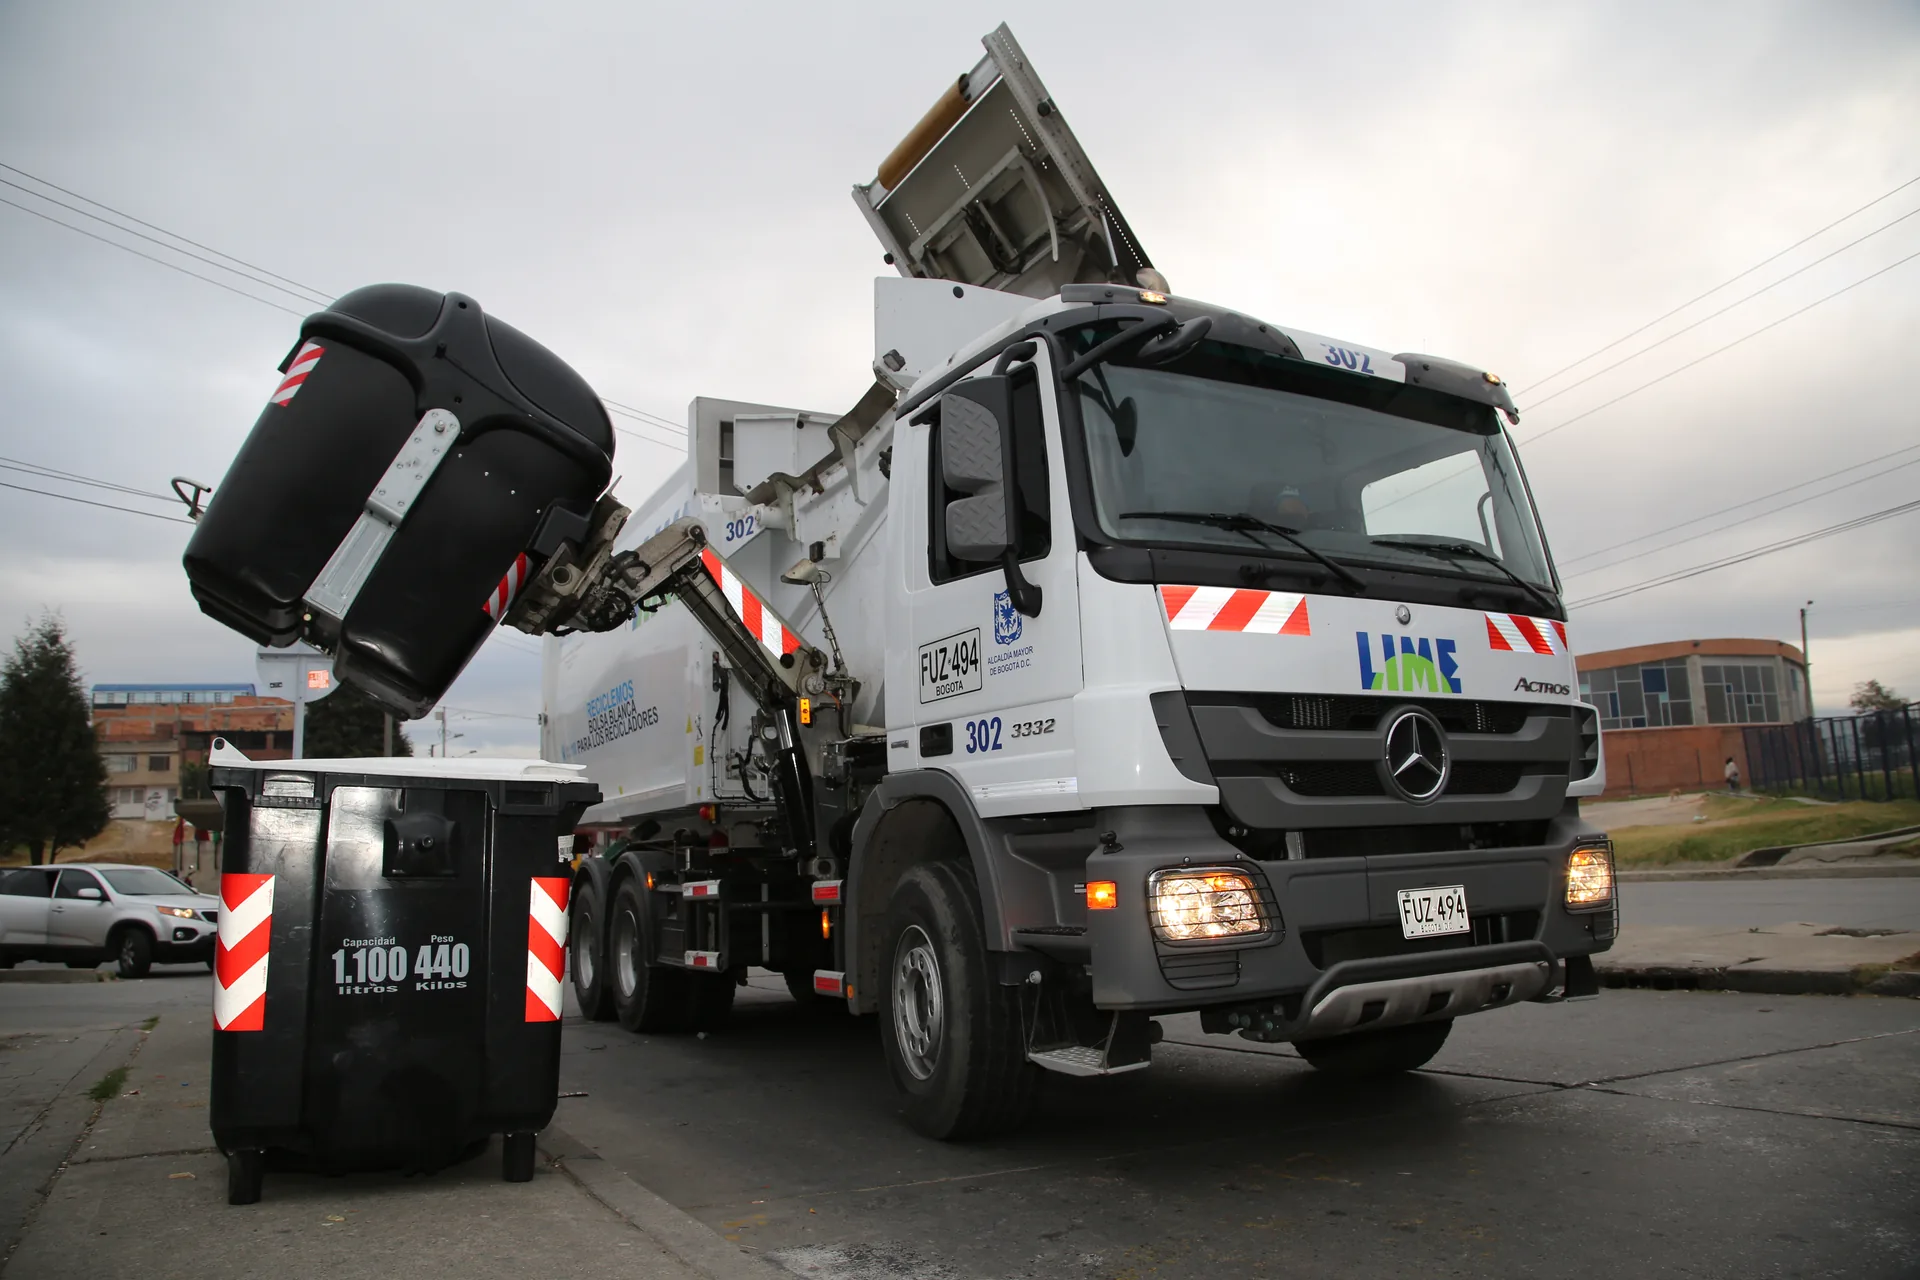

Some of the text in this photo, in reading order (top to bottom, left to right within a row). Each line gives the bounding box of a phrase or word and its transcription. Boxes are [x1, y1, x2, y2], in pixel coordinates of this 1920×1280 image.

[1321, 343, 1374, 374] 302
[726, 515, 754, 542] 302
[1012, 645, 1034, 657] MAYOR
[1356, 631, 1462, 694] LIME
[989, 668, 997, 676] DE
[1020, 658, 1032, 668] D.C.
[586, 679, 635, 718] RECICLEMOS
[936, 680, 964, 697] BOGOTA
[576, 736, 593, 754] PARA
[592, 726, 605, 748] LOS
[605, 706, 659, 743] RECICLADORES
[588, 699, 637, 734] BOLSA BLANCA
[1011, 718, 1056, 739] 3332
[965, 716, 1003, 754] 302
[343, 934, 454, 948] Capacidad Peso
[331, 943, 470, 984] 1.100 440
[338, 981, 468, 996] litros Kilos
